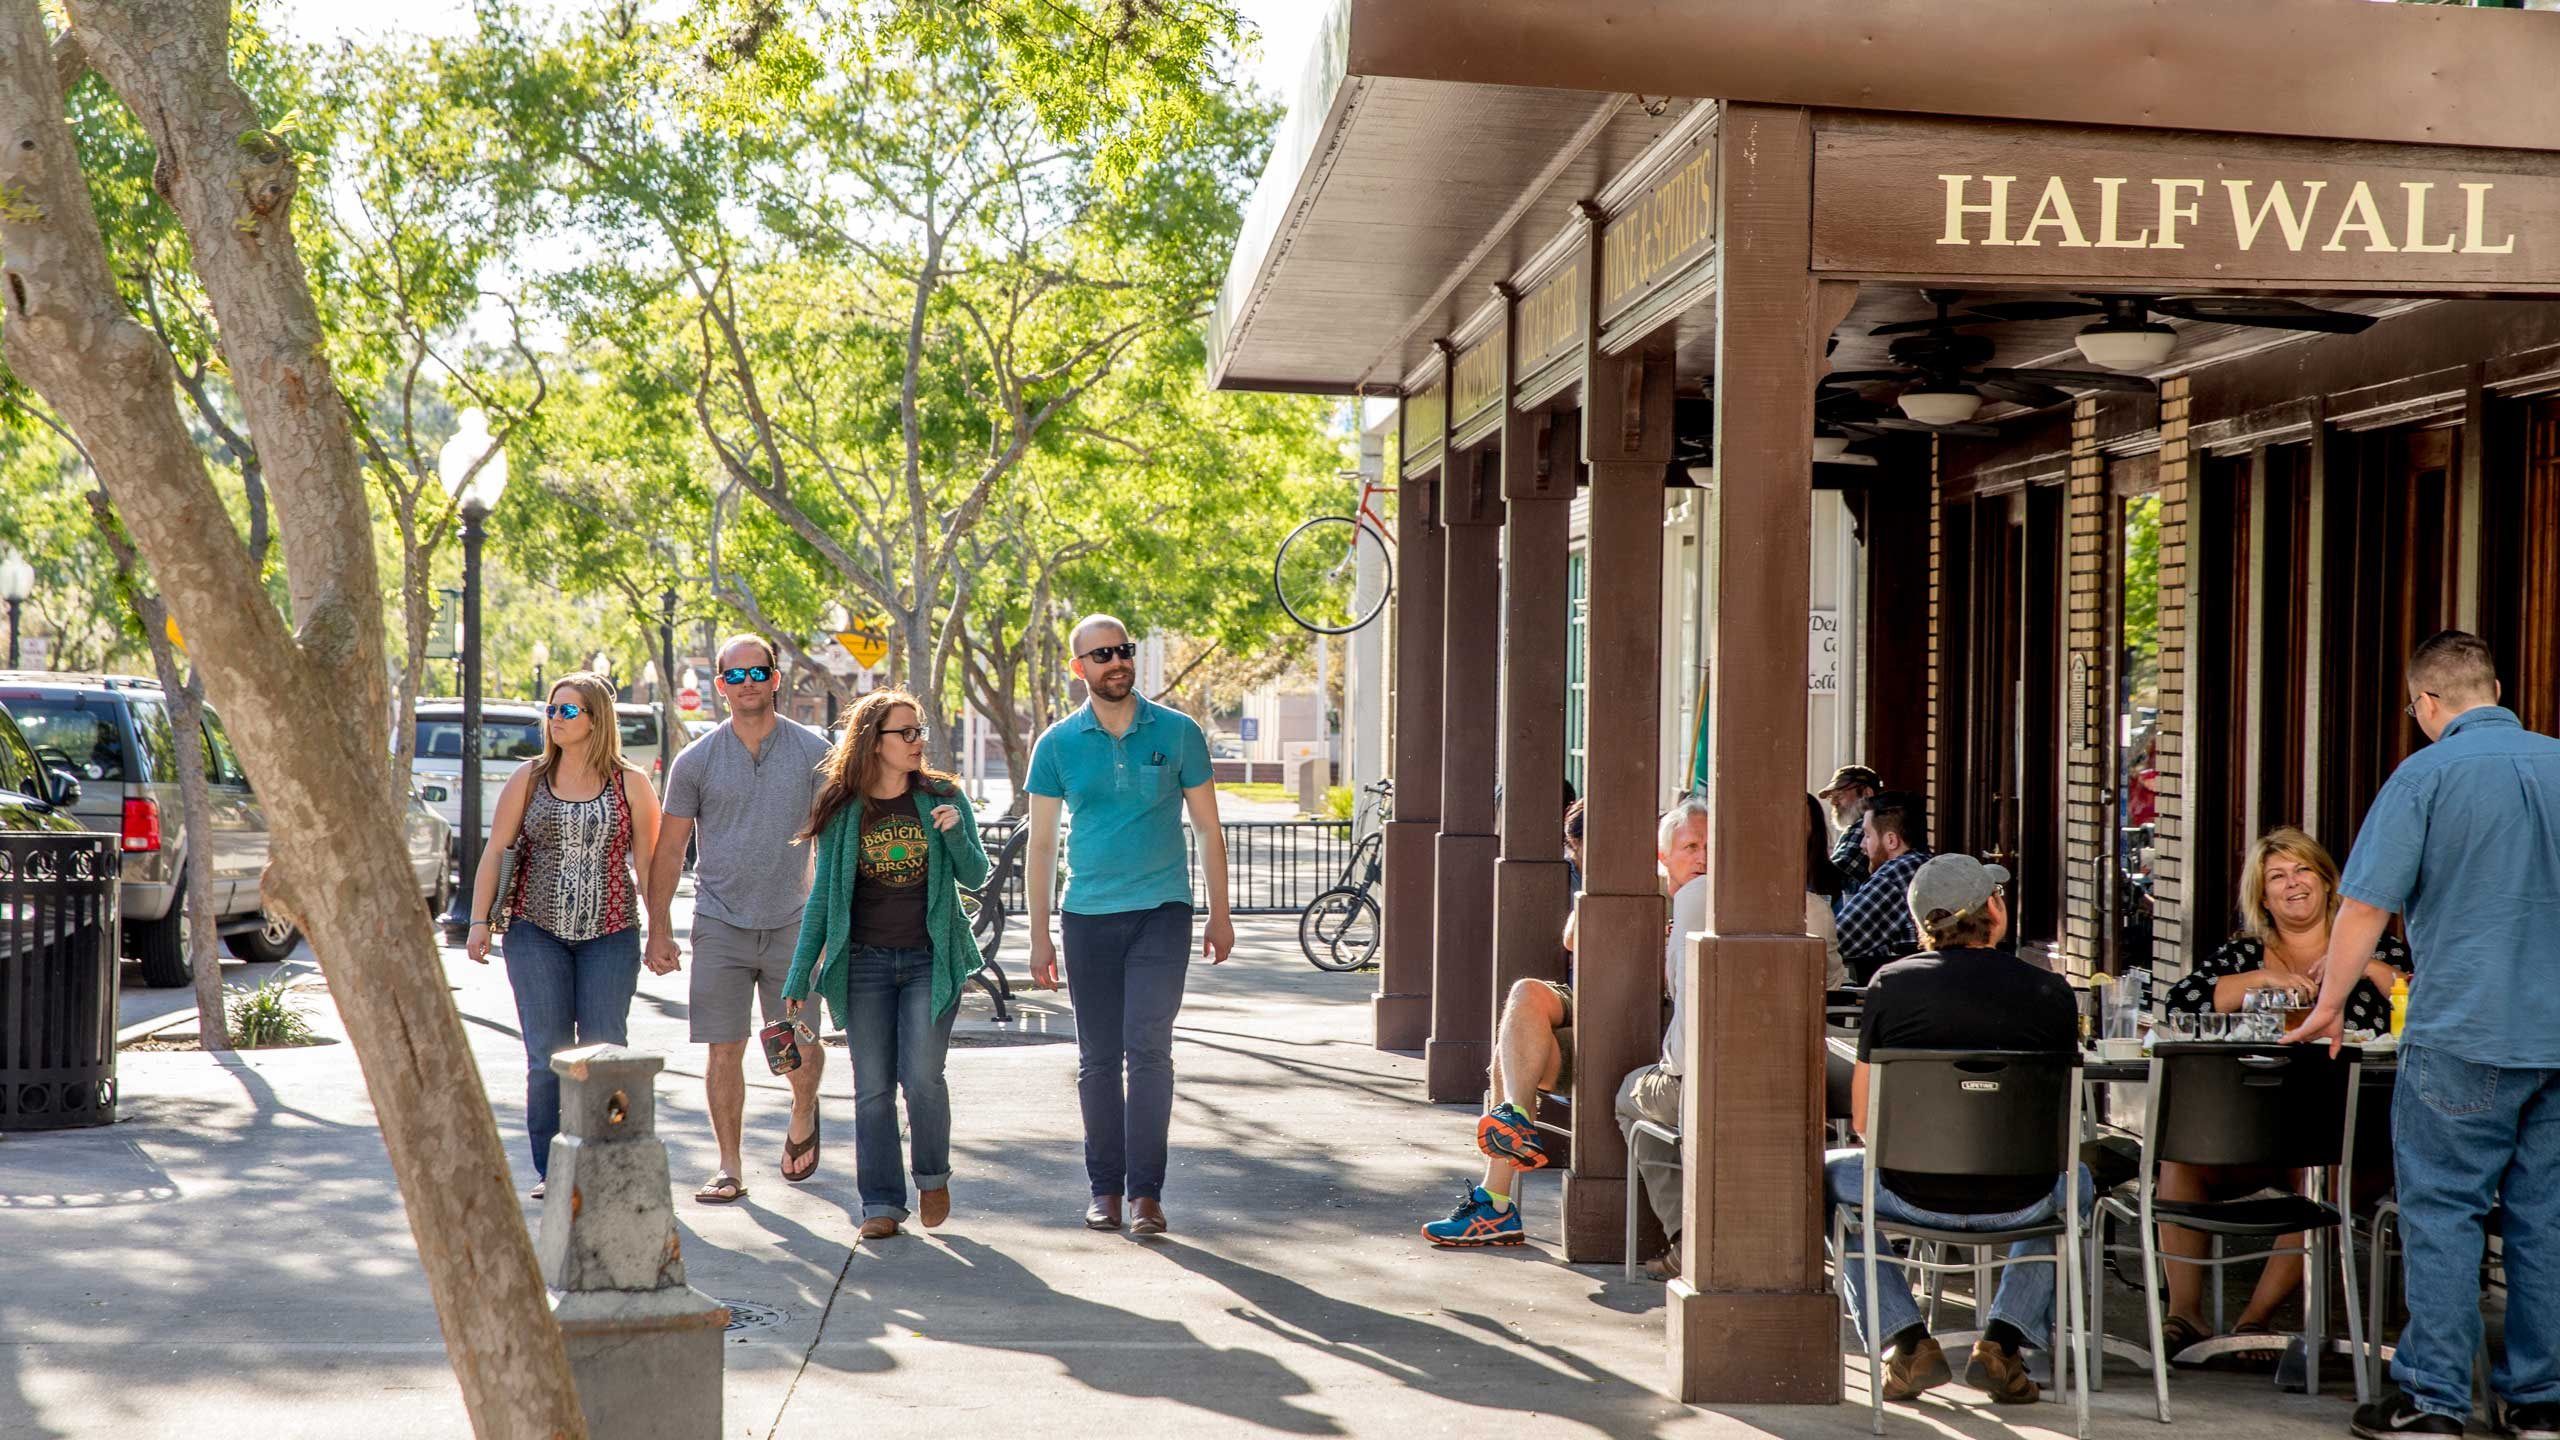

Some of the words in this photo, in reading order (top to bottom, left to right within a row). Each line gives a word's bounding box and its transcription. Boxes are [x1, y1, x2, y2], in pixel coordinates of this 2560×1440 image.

[1605, 210, 1638, 304] WINE
[1639, 202, 1652, 283] &
[1653, 149, 1711, 273] SPIRITS
[1936, 174, 2205, 249] HALF
[2221, 179, 2515, 253] WALL
[1552, 264, 1577, 347] BEER
[875, 857, 923, 873] BREW
